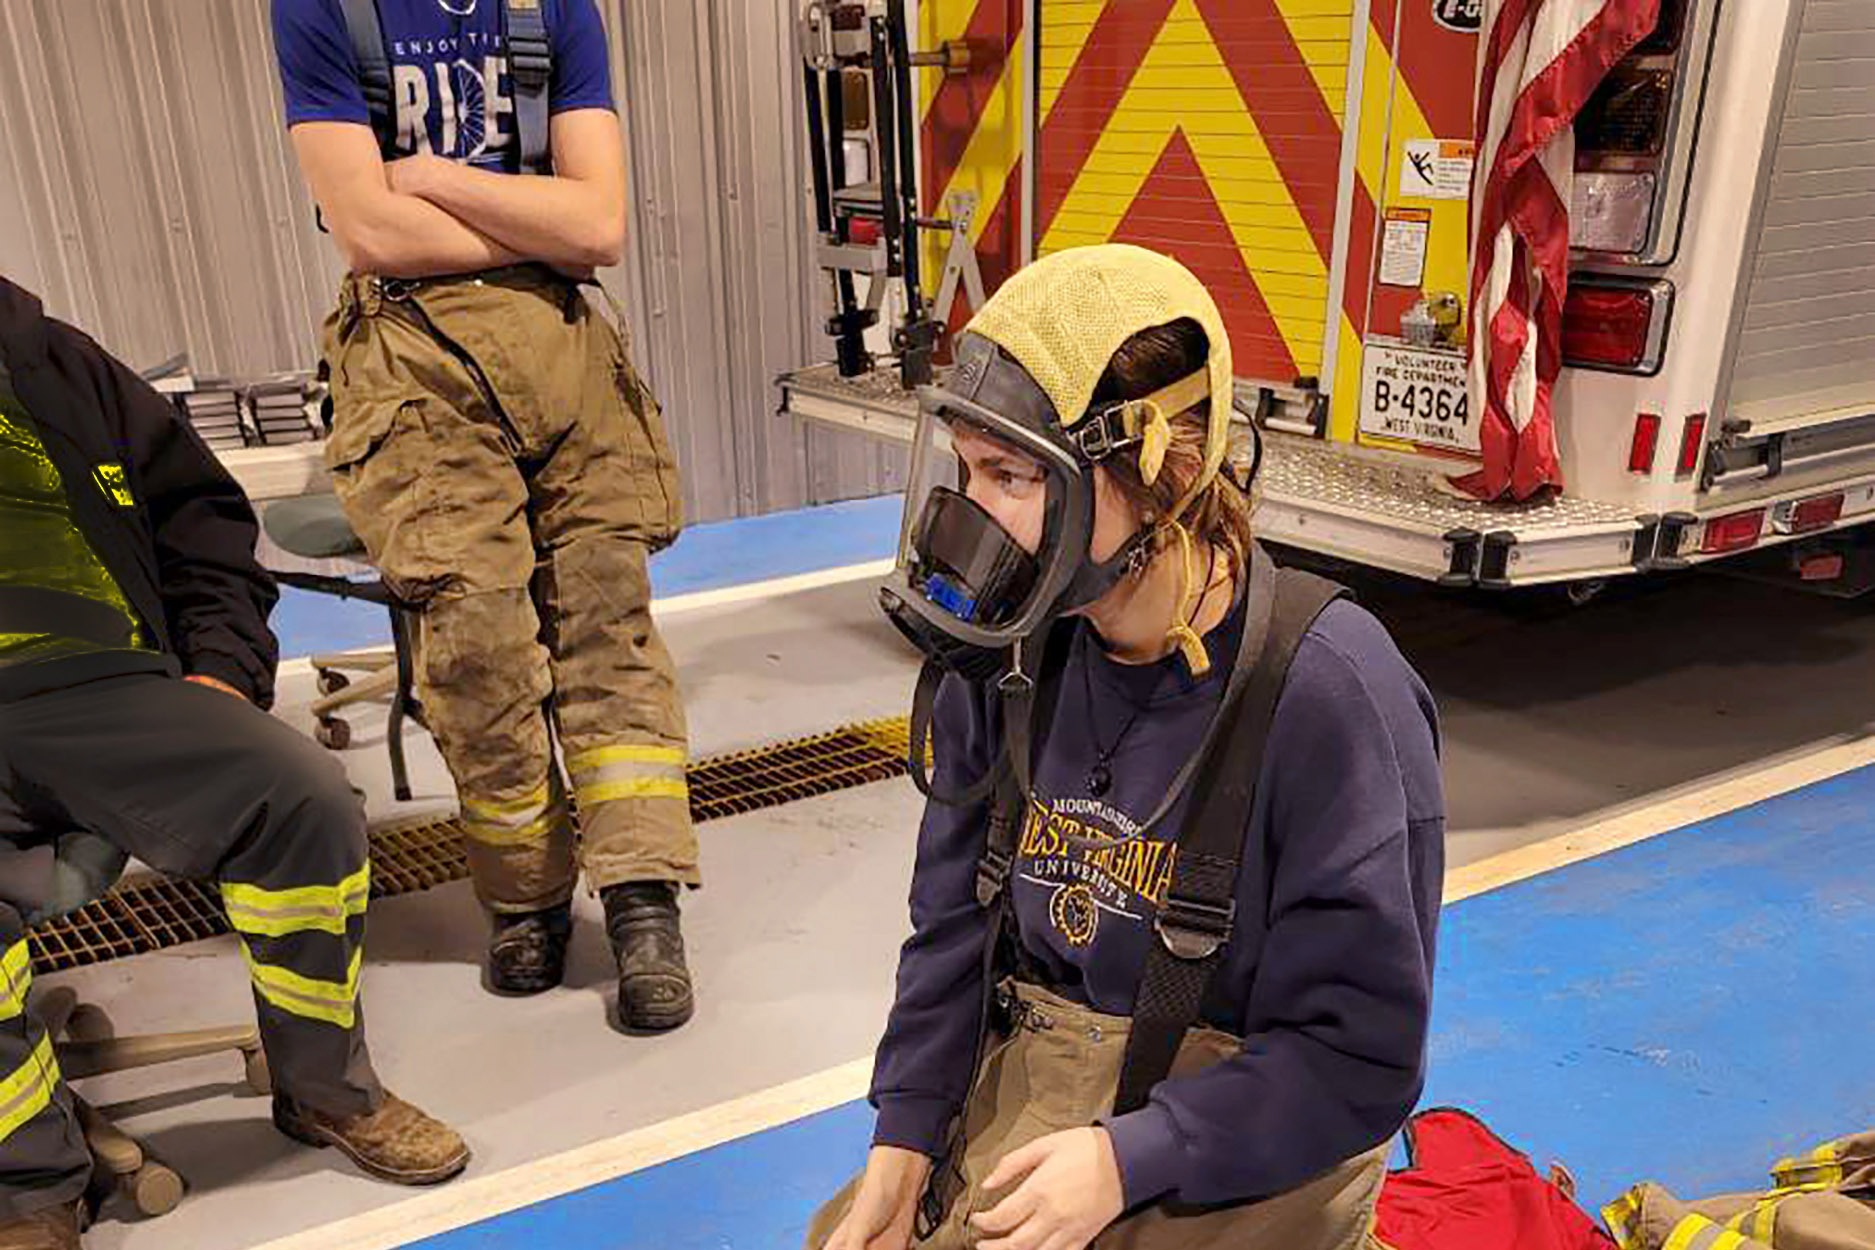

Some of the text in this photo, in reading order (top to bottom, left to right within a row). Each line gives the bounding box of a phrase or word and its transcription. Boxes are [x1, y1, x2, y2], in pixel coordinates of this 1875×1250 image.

[394, 38, 458, 55] ENJOY
[1394, 353, 1456, 371] VOLUNTEER
[1376, 365, 1467, 388] FIRE DEPARTMEN
[1384, 415, 1410, 433] WEST
[1033, 859, 1129, 909] UNIVERSITY
